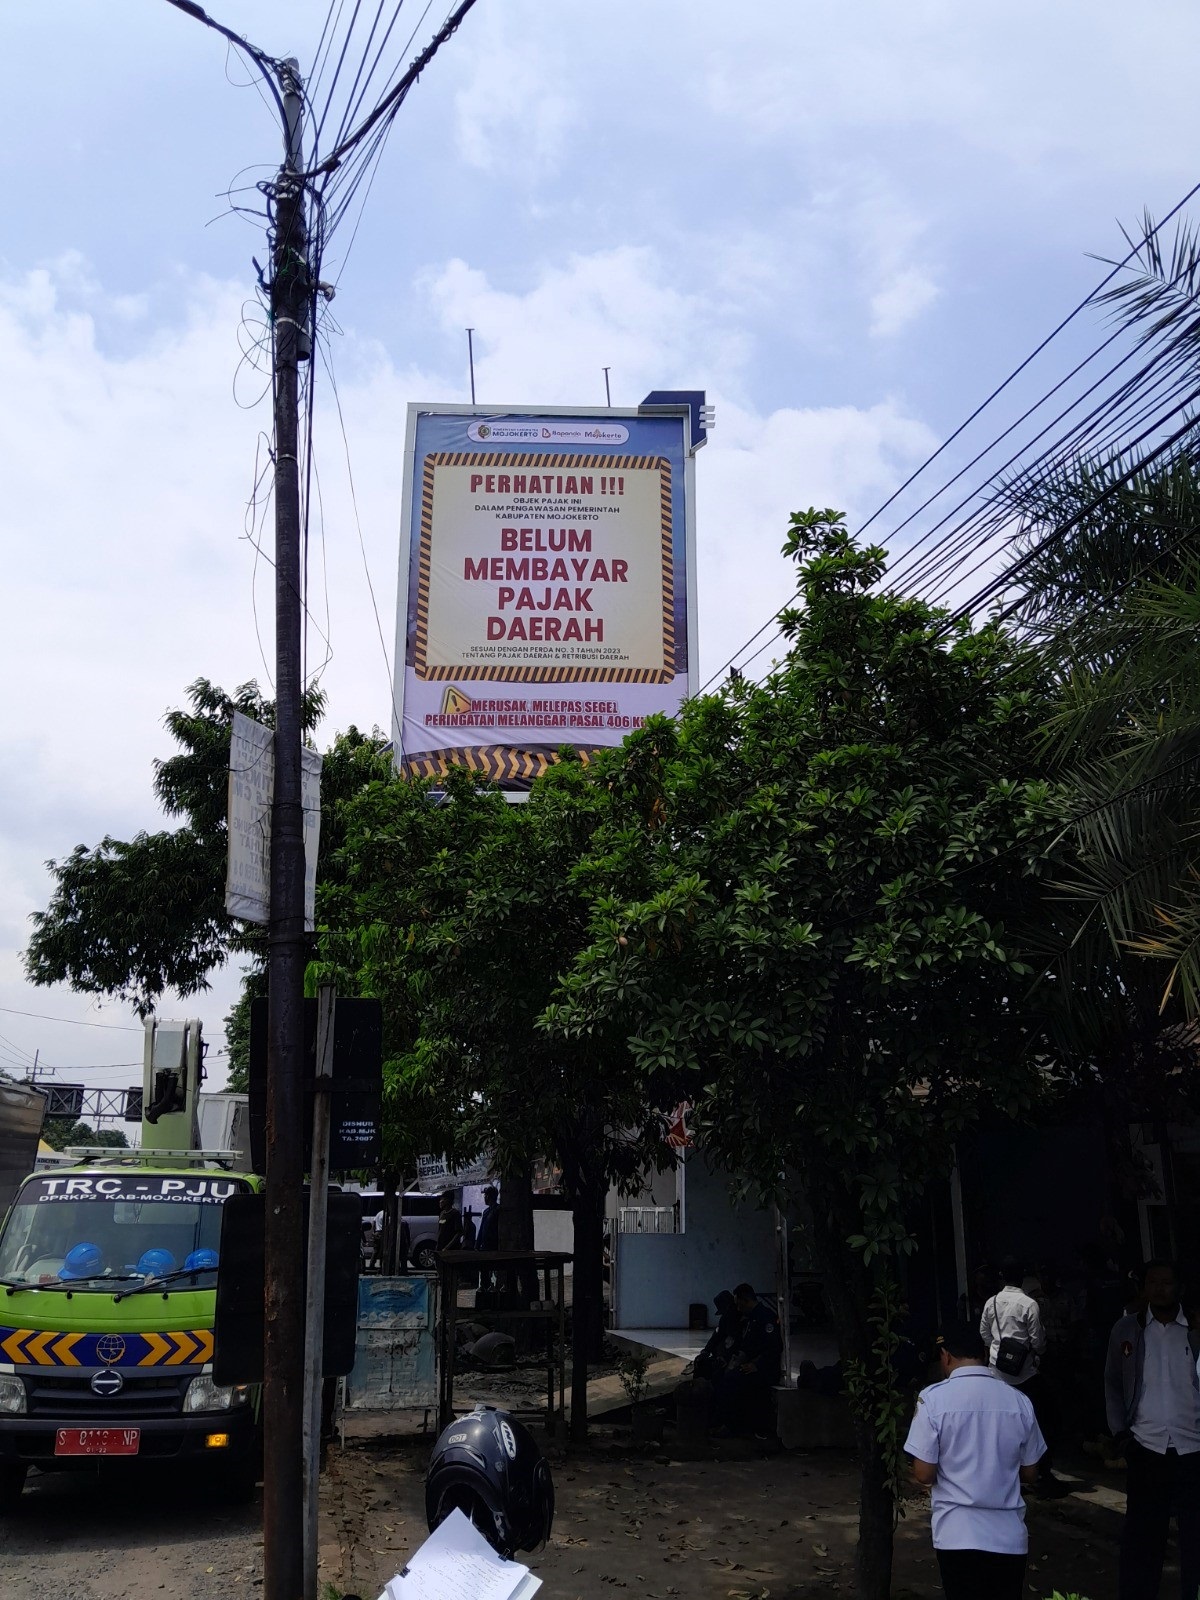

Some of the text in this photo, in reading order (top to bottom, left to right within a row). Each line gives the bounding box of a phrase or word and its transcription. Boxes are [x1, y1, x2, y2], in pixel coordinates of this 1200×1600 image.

[470, 474, 625, 496] PERHATIAN !!!
[474, 504, 620, 514] DALAM PENGAWASAN PEMERINTAH
[501, 528, 592, 552] BELUM
[464, 557, 628, 583] MEMBAYAR
[498, 587, 594, 612] PAJAK
[486, 616, 604, 642] DAERAH
[471, 699, 530, 713] MERUSAK,
[532, 700, 582, 713] MELEPAS
[425, 714, 495, 726] PERINGATAN
[497, 715, 567, 727] MELANGGAR
[569, 715, 605, 727] PASAL
[607, 716, 630, 728] 406
[418, 1164, 445, 1177] SEPEDA
[41, 1178, 122, 1195] TRC
[161, 1180, 236, 1199] PJU
[39, 1194, 97, 1202] DPRKP2
[58, 1430, 67, 1446] S
[450, 1434, 465, 1443] DOT
[502, 1424, 515, 1454] INK
